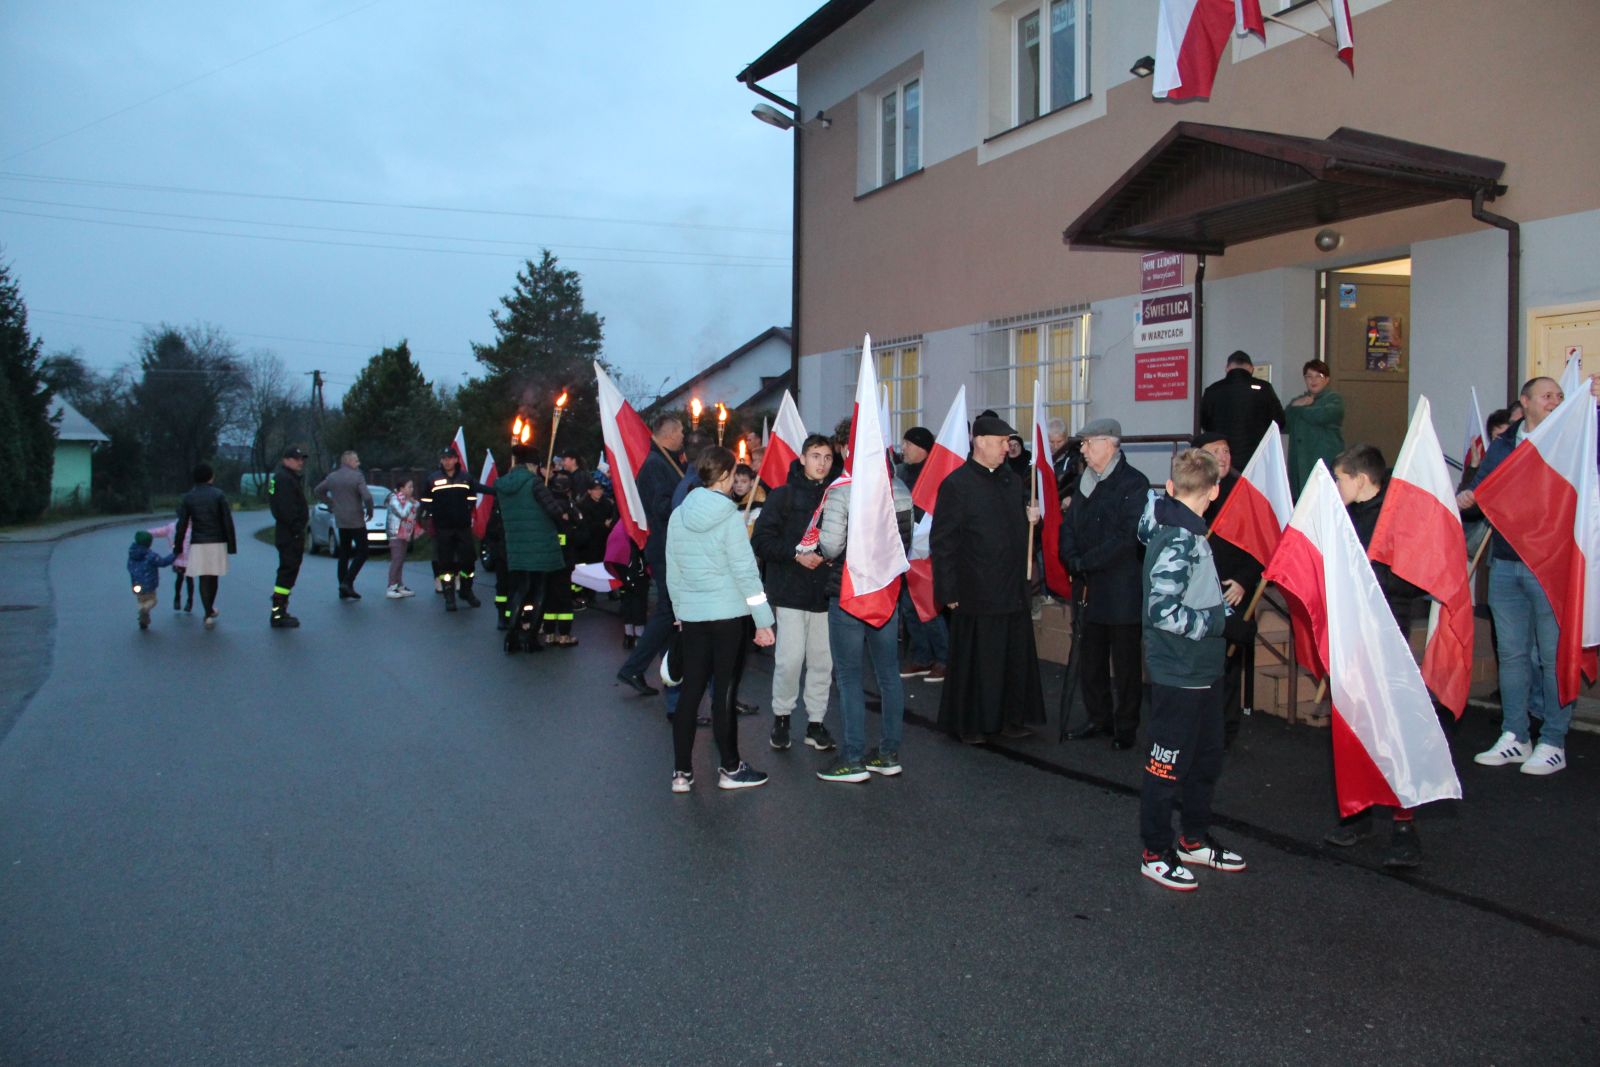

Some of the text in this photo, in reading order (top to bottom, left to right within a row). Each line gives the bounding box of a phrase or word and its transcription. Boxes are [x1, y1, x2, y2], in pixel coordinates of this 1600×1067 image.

[1144, 300, 1189, 319] ŚWIETLICA
[1141, 328, 1184, 342] W WARZYCACH
[1150, 742, 1180, 764] JUST
